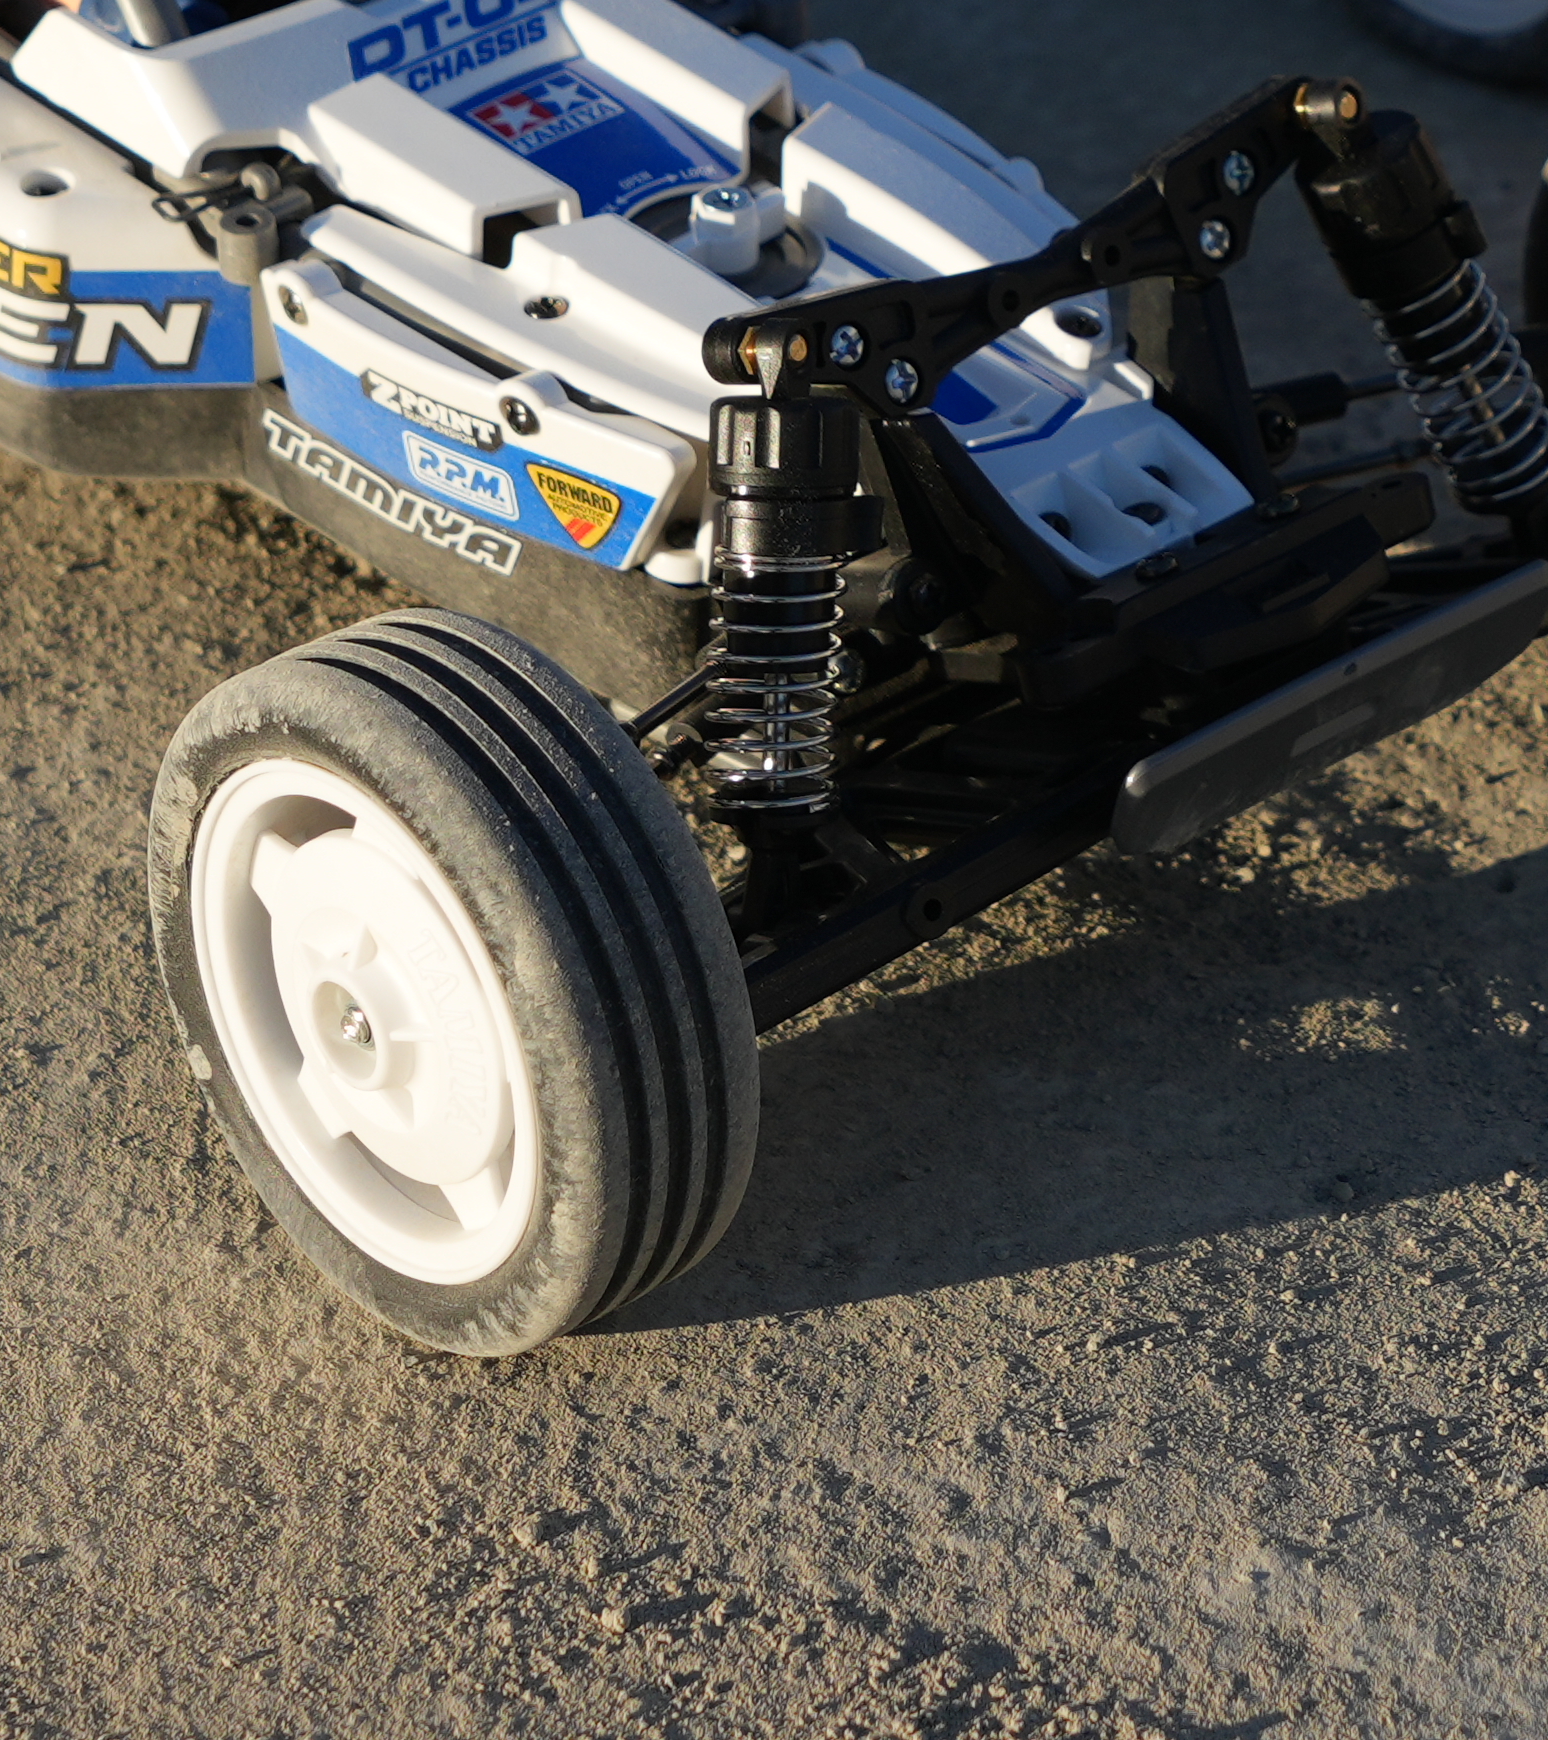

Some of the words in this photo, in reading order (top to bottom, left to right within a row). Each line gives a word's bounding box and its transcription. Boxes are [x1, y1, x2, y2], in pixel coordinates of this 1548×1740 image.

[407, 15, 548, 94] CHASSIS
[512, 96, 625, 154] TAMIYA
[263, 408, 522, 577] TAMIYA
[418, 445, 506, 503] R.P.M.
[536, 470, 613, 514] FORWARD
